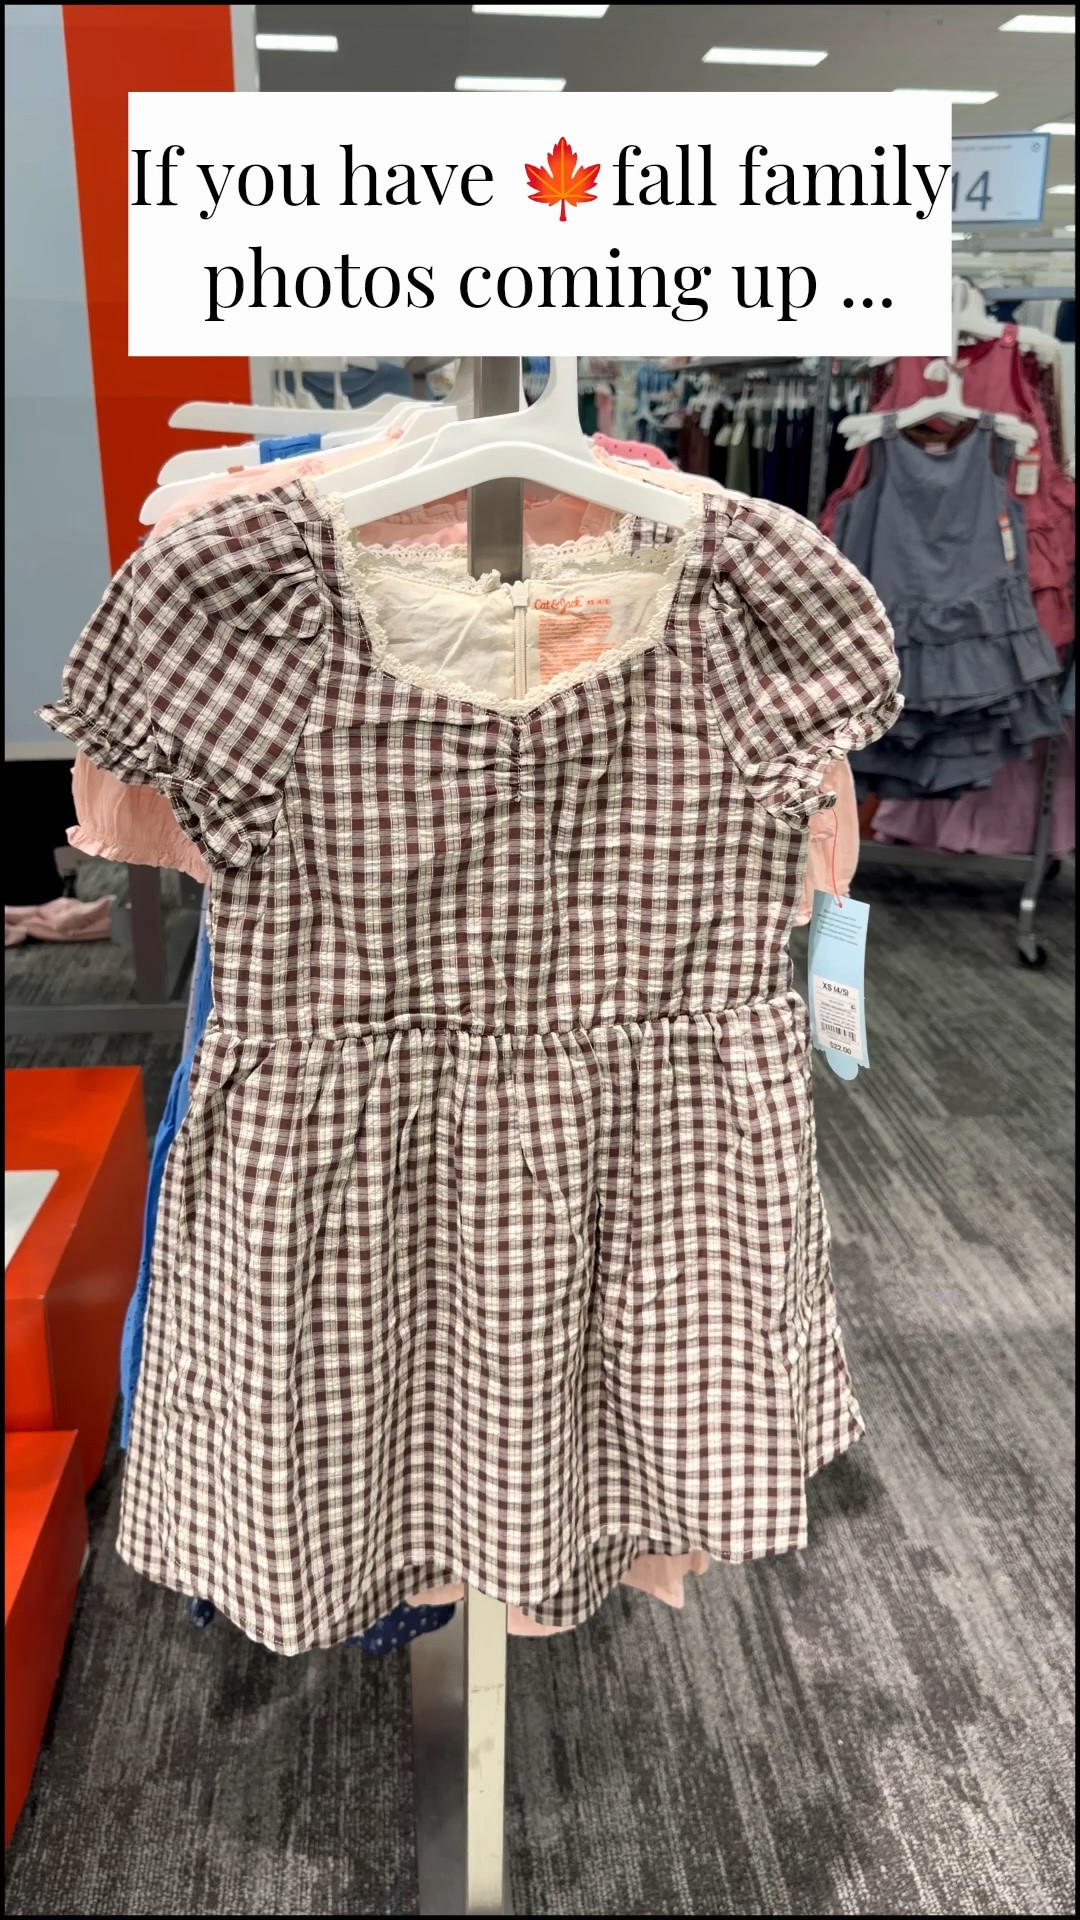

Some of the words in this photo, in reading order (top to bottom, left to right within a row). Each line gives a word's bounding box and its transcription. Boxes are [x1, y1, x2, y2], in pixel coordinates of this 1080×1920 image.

[951, 170, 992, 212] 14
[822, 981, 833, 992] XS
[834, 986, 849, 997] (4/5)
[829, 1041, 852, 1056] $22.00
